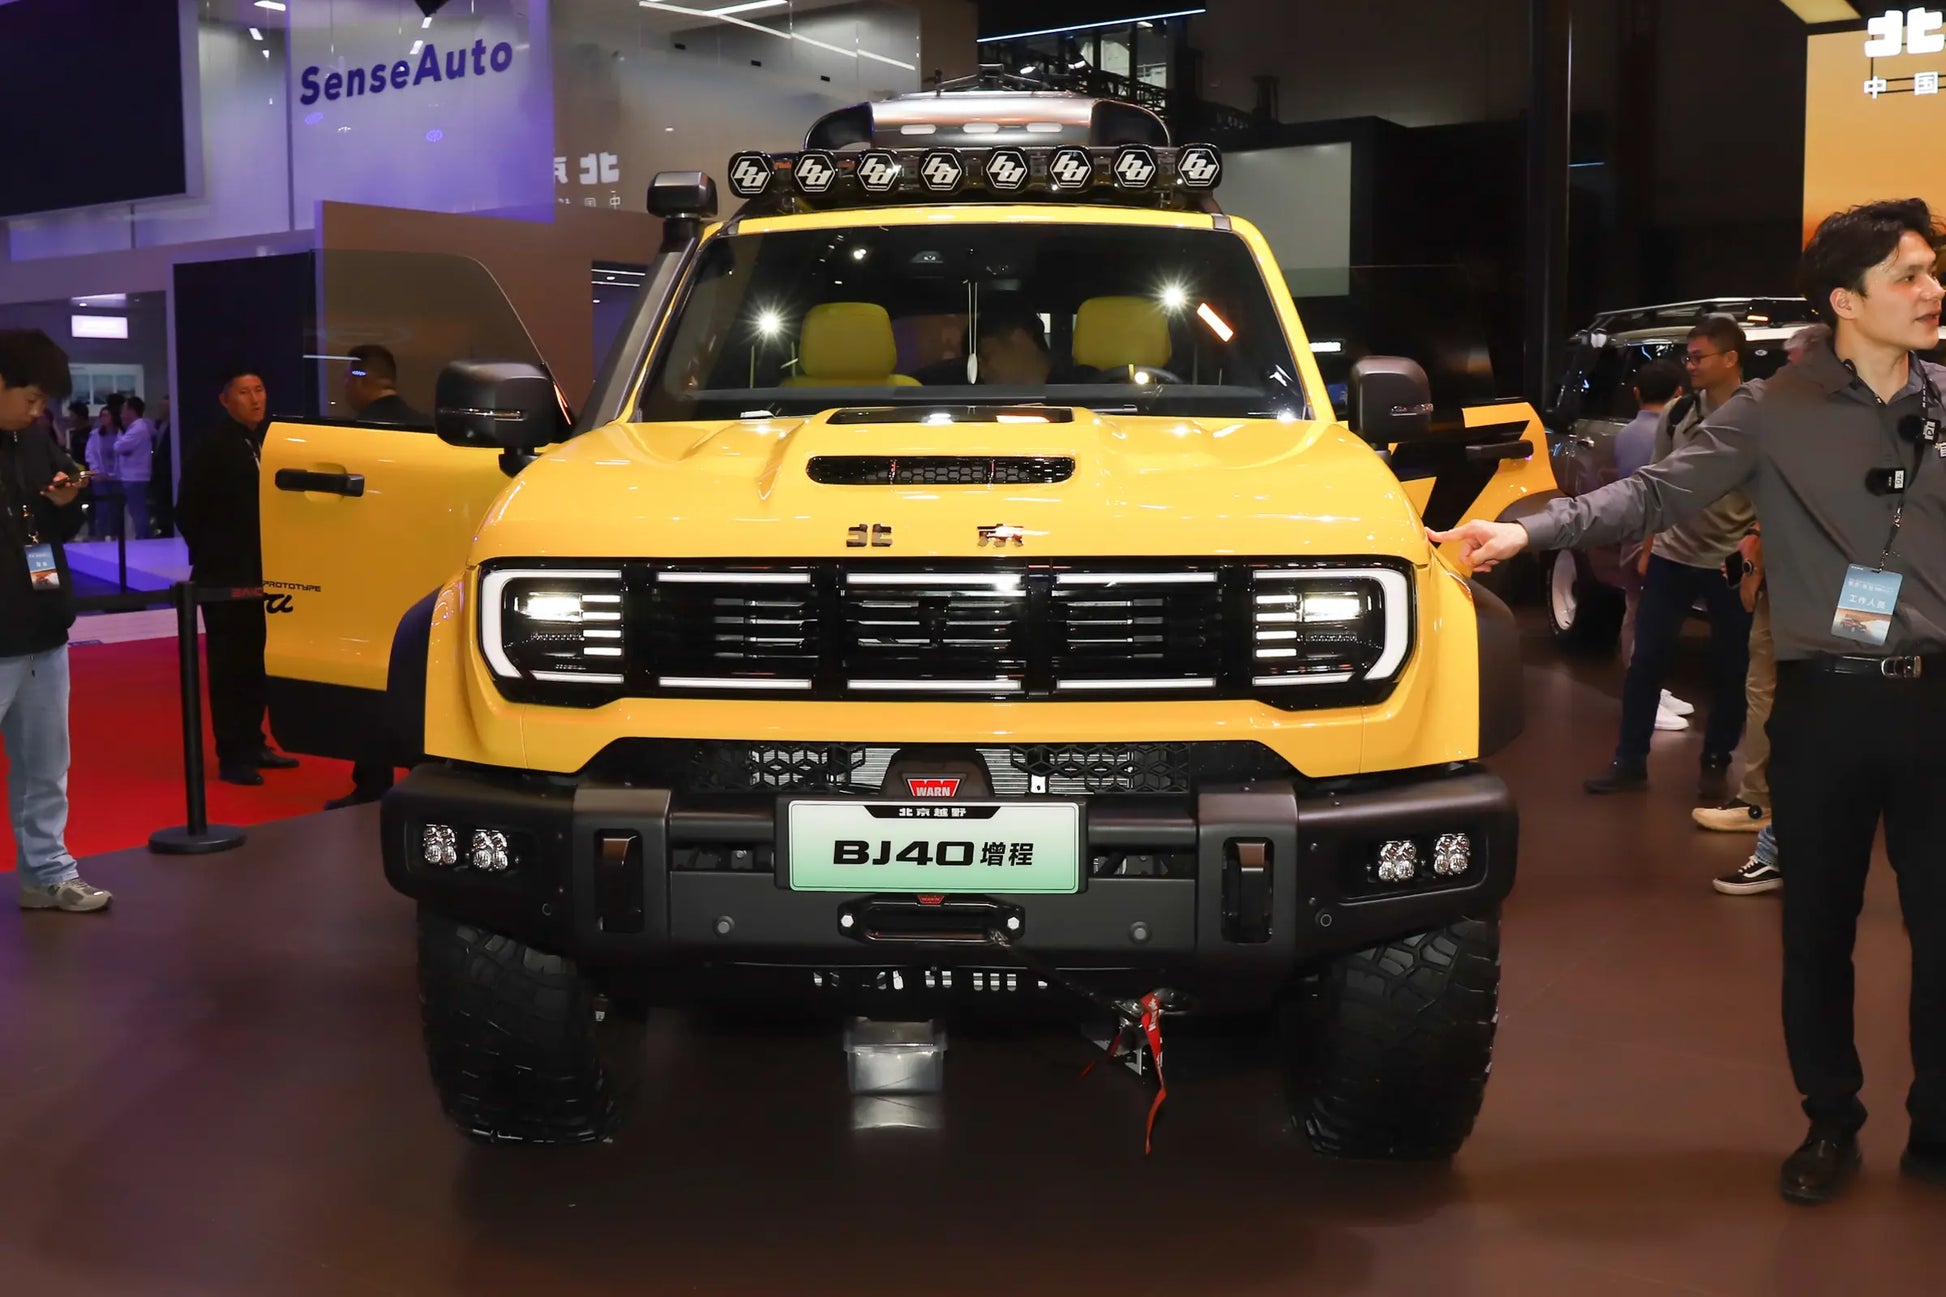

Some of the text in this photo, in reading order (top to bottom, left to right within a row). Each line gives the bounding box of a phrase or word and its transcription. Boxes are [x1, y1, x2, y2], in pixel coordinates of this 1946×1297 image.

[300, 38, 512, 105] SenseAuto
[1864, 72, 1939, 100] 中国
[916, 786, 951, 797] WARN
[898, 807, 967, 818] 北京越野
